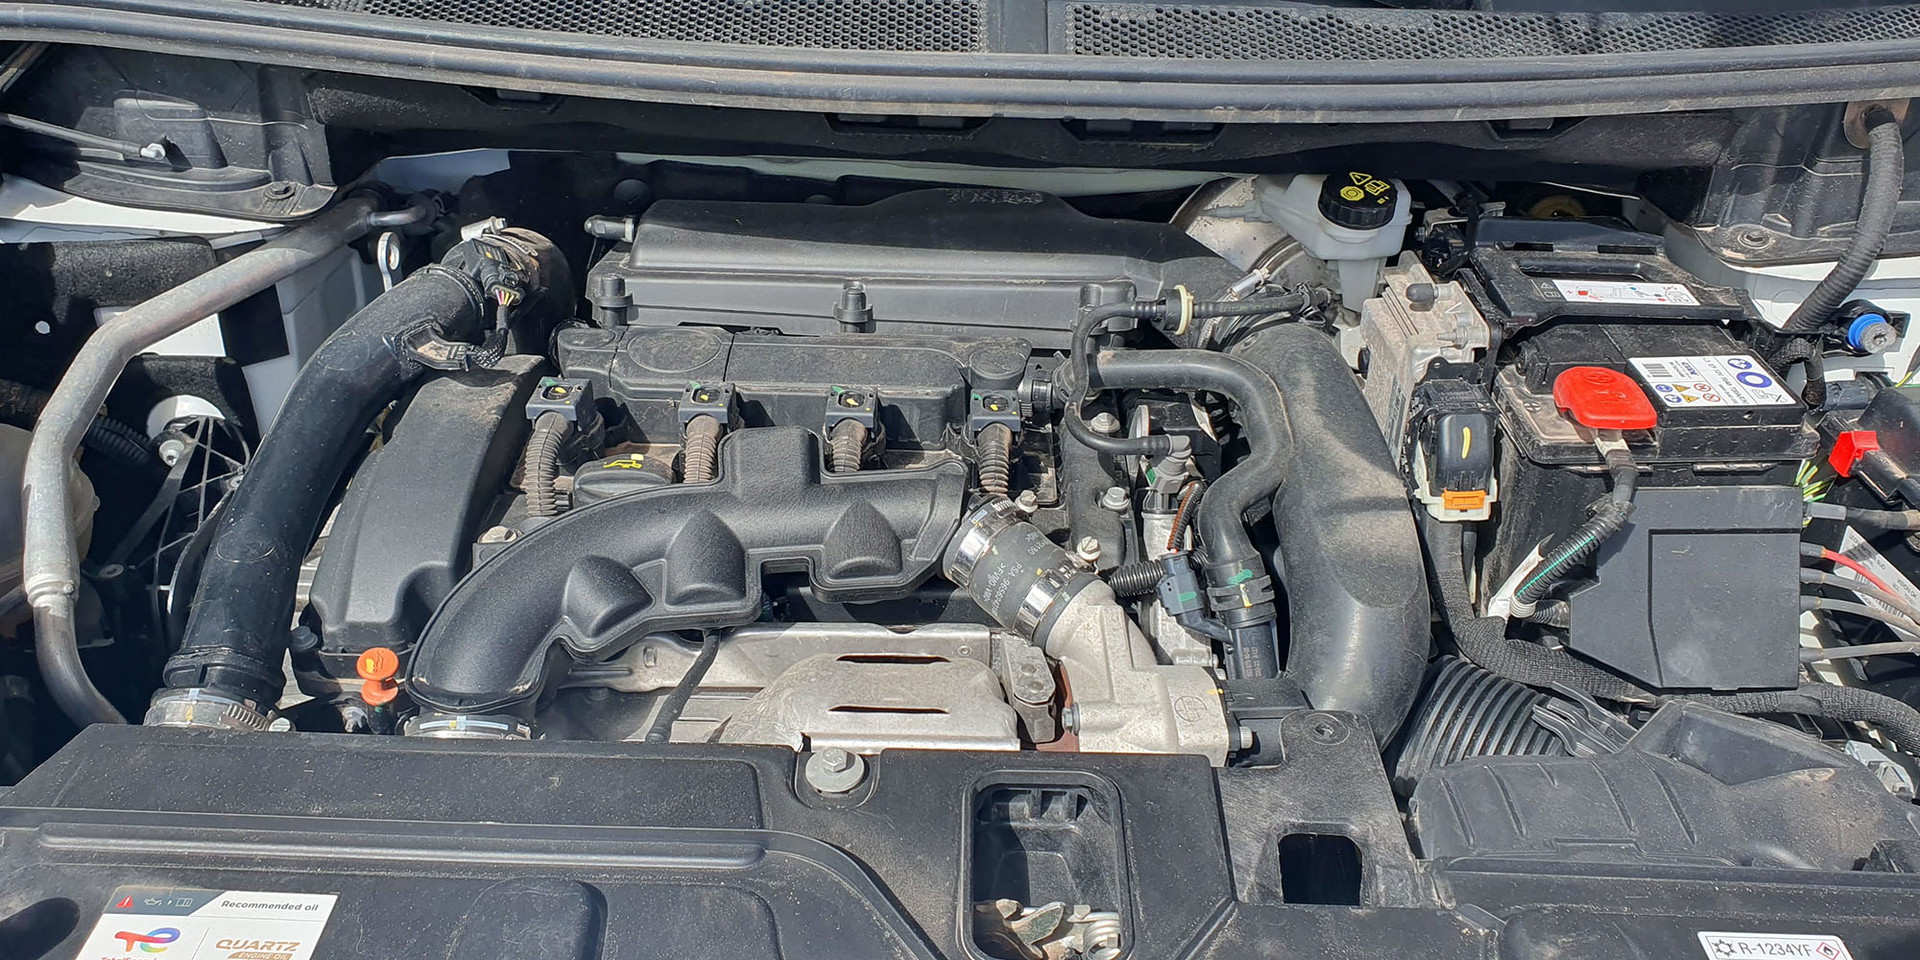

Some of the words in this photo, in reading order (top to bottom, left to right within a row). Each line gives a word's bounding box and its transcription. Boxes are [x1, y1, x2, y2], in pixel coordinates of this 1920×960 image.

[1008, 561, 1023, 577] PSA
[220, 900, 302, 912] Recommended
[304, 902, 319, 911] oil
[215, 939, 301, 952] QUARTZ
[1738, 942, 1813, 958] R-1234YF
[238, 952, 273, 960] ENGINE
